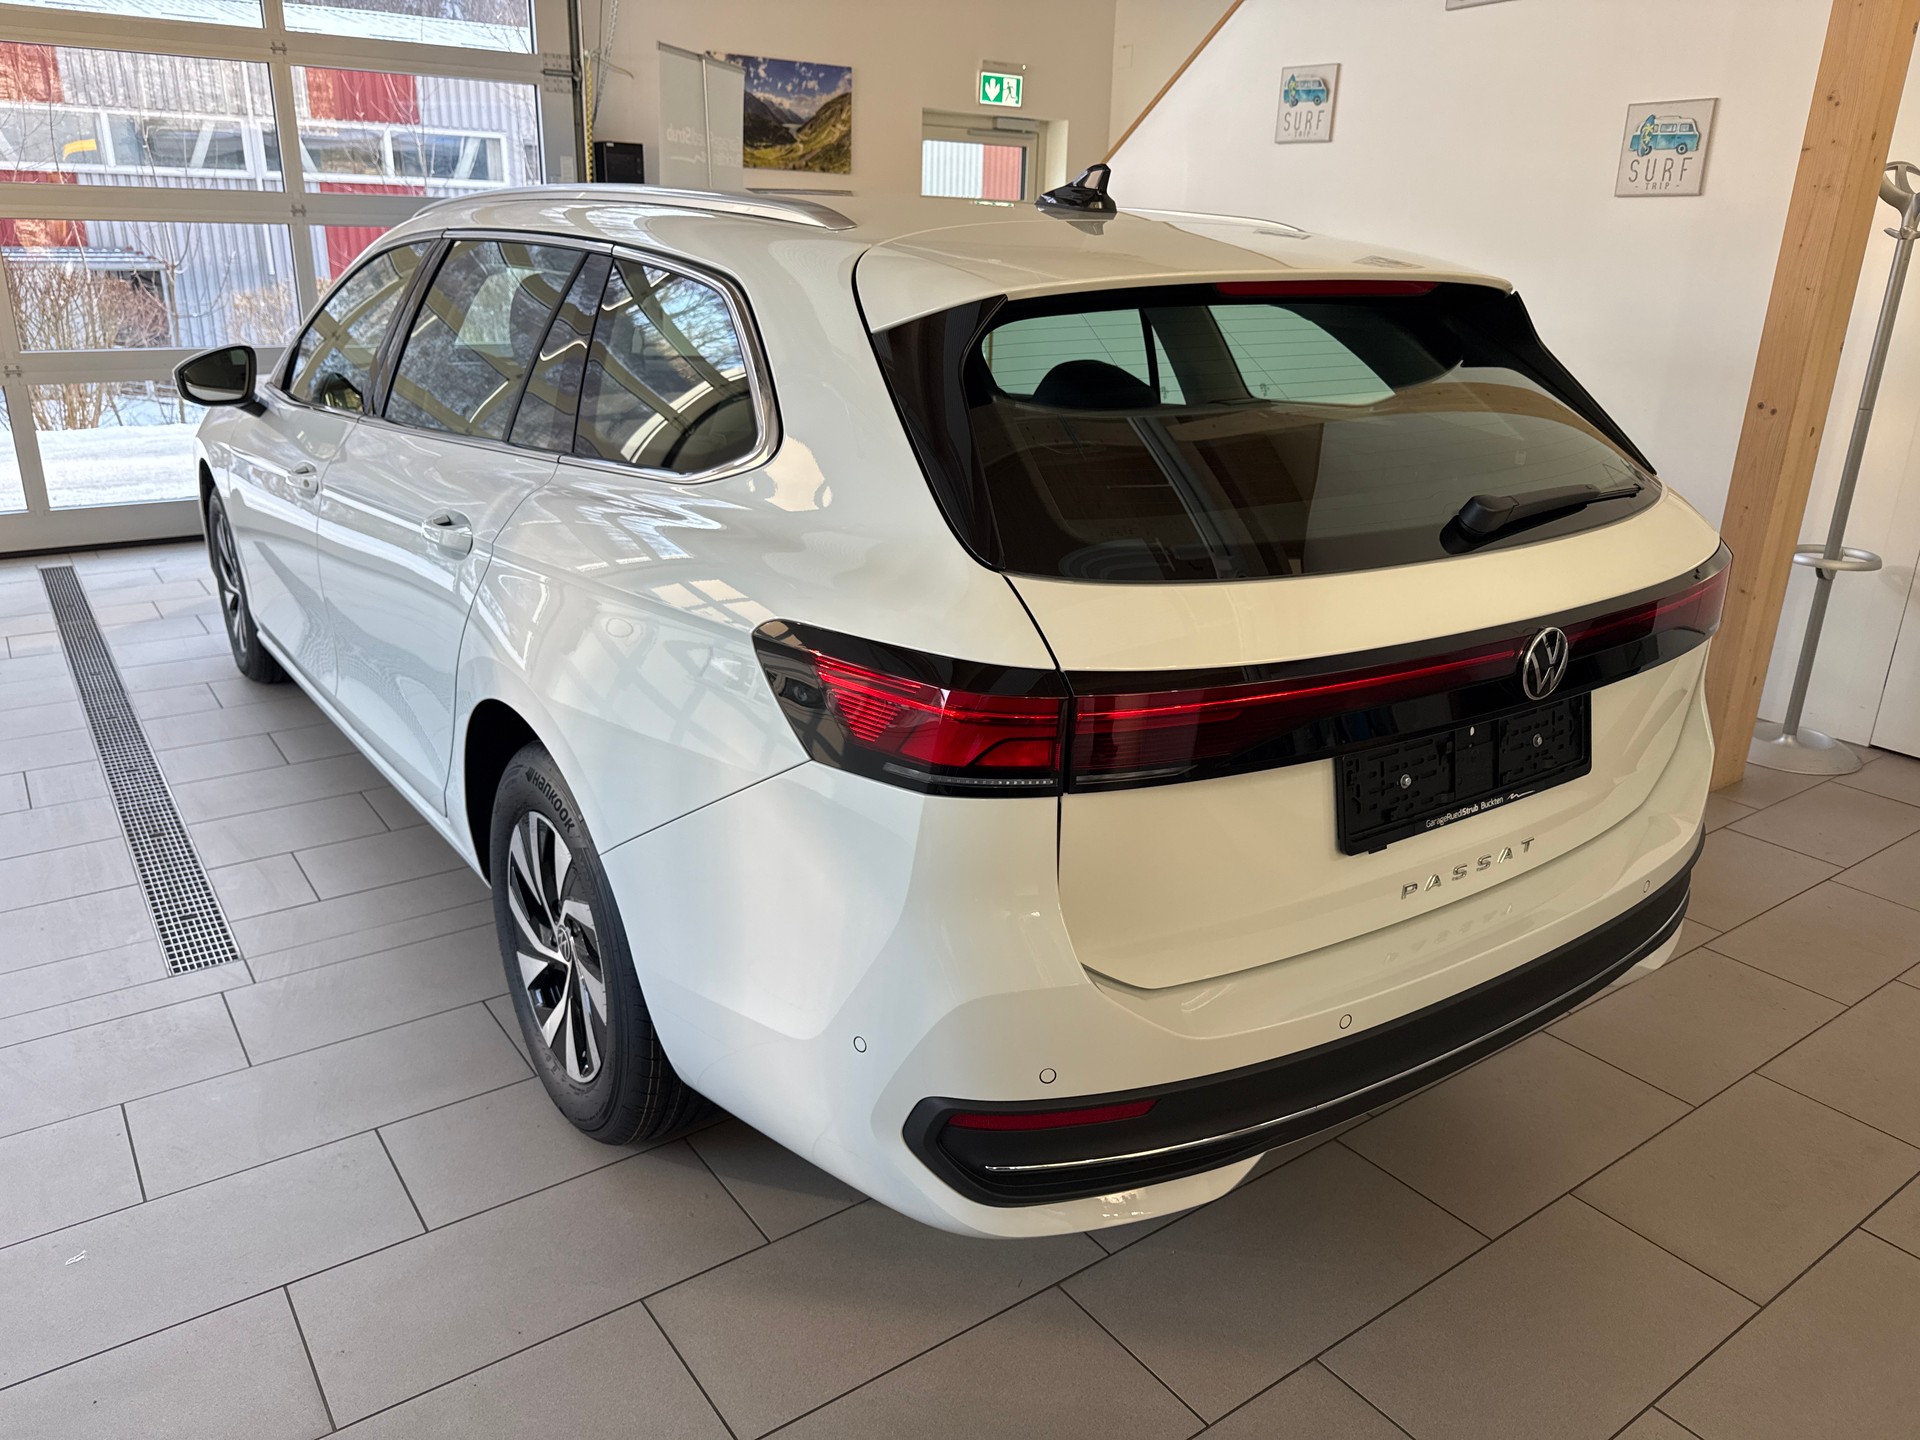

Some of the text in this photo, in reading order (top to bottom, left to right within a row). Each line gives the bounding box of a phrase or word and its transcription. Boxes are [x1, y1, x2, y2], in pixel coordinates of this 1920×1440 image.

[1283, 110, 1325, 131] SURF
[1629, 157, 1693, 182] SURF
[1645, 182, 1670, 190] TRIP
[1480, 796, 1503, 810] Buckten
[1401, 837, 1535, 900] PASSAT
